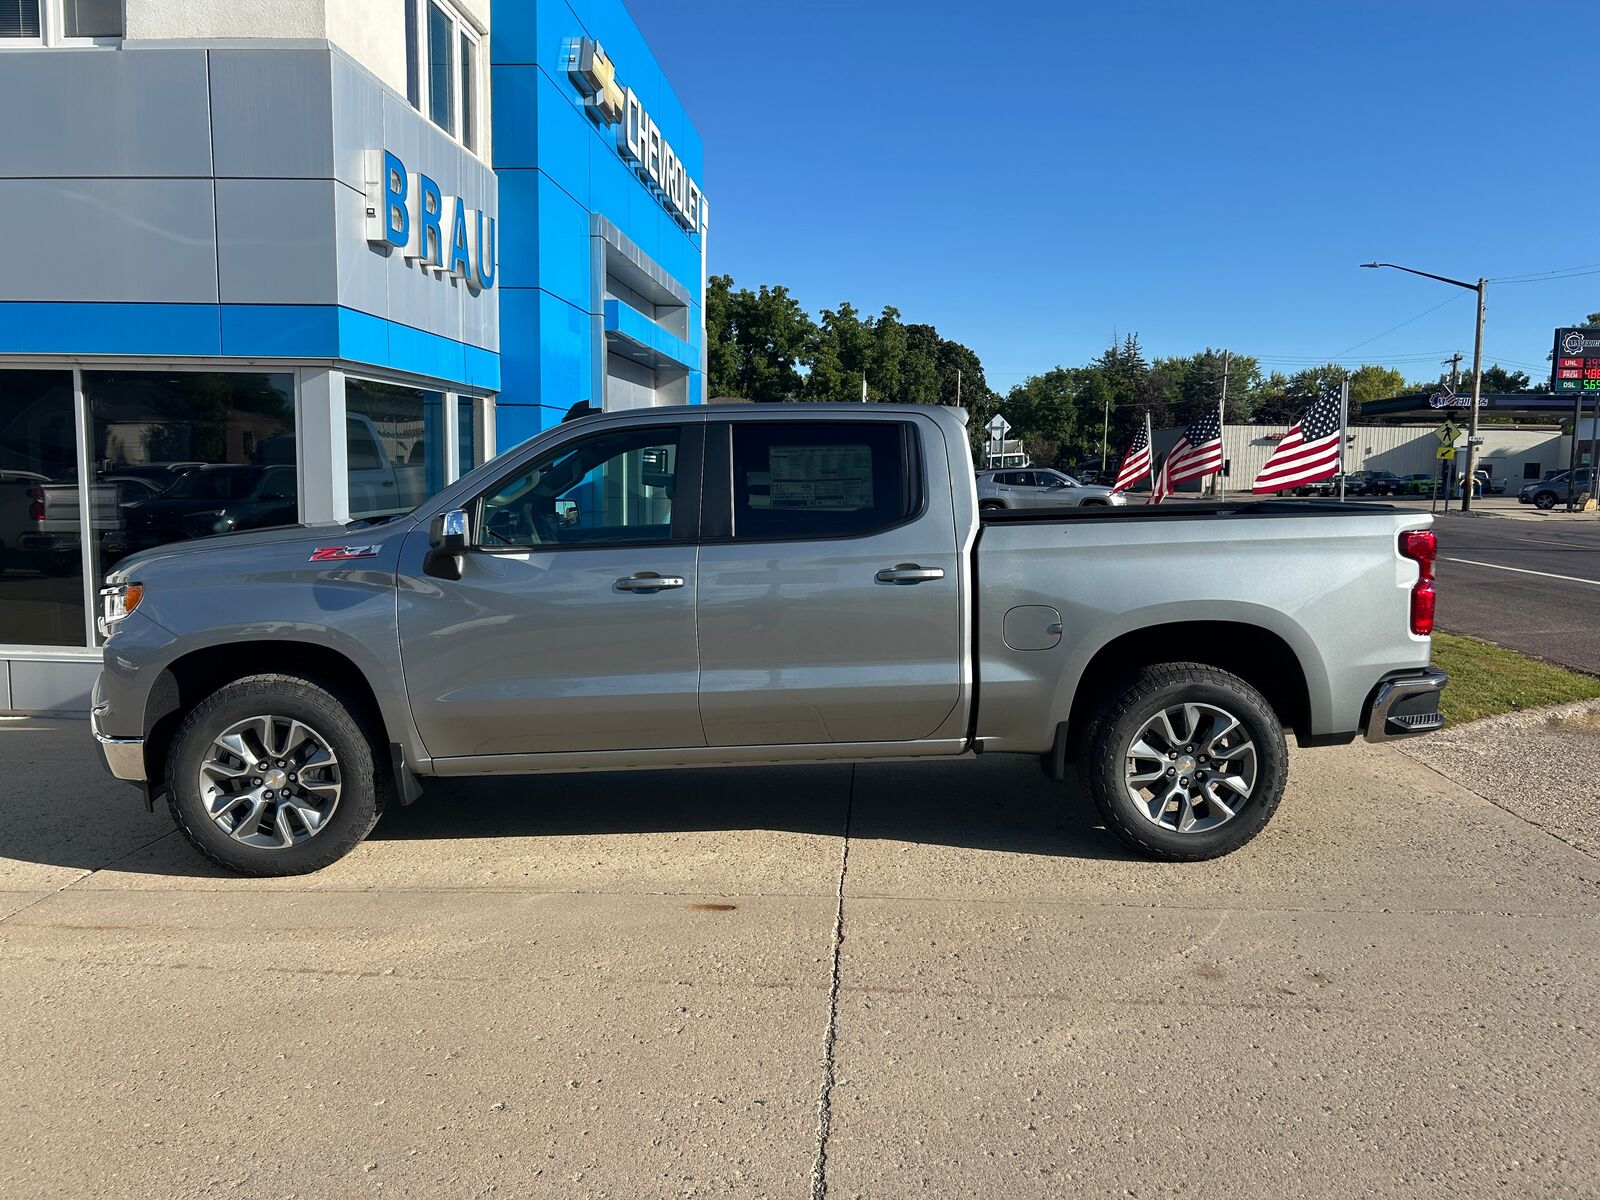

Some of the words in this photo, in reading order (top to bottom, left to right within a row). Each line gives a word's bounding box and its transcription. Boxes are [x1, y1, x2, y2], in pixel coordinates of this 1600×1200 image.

[384, 149, 496, 289] BRAU
[626, 86, 702, 234] CHEVROLET
[308, 544, 383, 562] Z71
